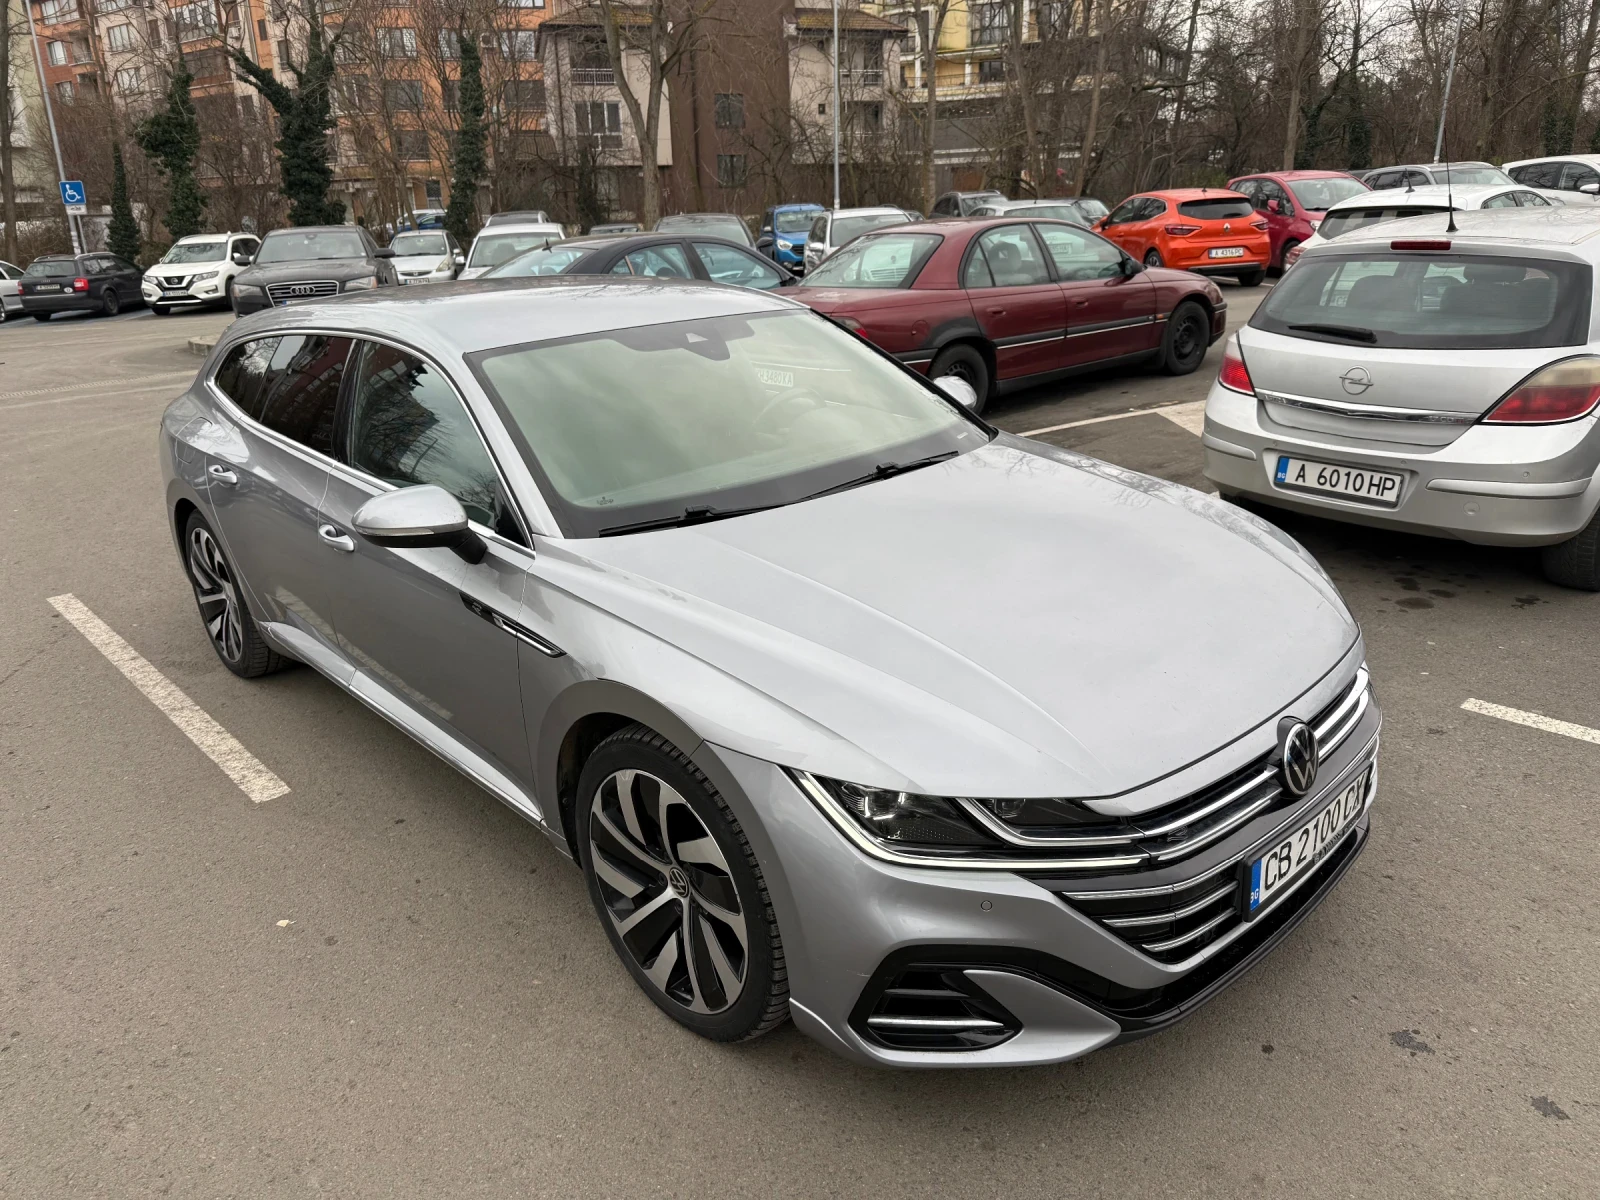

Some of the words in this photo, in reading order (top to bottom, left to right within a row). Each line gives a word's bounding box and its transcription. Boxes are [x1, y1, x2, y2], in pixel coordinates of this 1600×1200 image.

[1294, 463, 1306, 483] A
[1317, 467, 1365, 492] 6010
[1367, 475, 1396, 497] HP
[1264, 841, 1292, 891] CB
[1296, 798, 1341, 866] 2100
